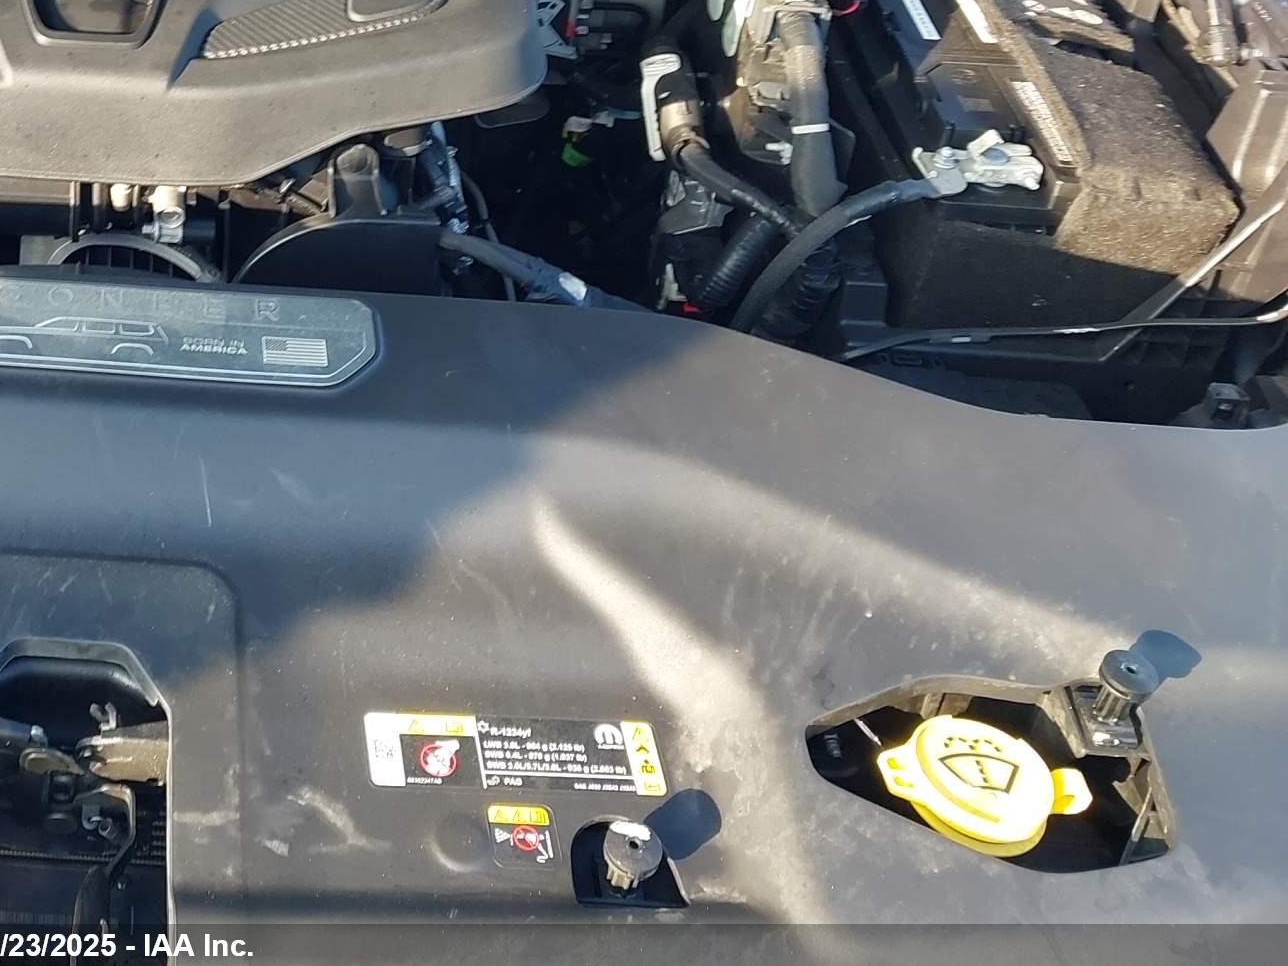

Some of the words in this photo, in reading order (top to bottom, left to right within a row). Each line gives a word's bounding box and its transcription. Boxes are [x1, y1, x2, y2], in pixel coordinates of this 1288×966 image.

[183, 336, 225, 347] BORN
[229, 338, 245, 348] IN
[180, 343, 248, 355] AMERICA
